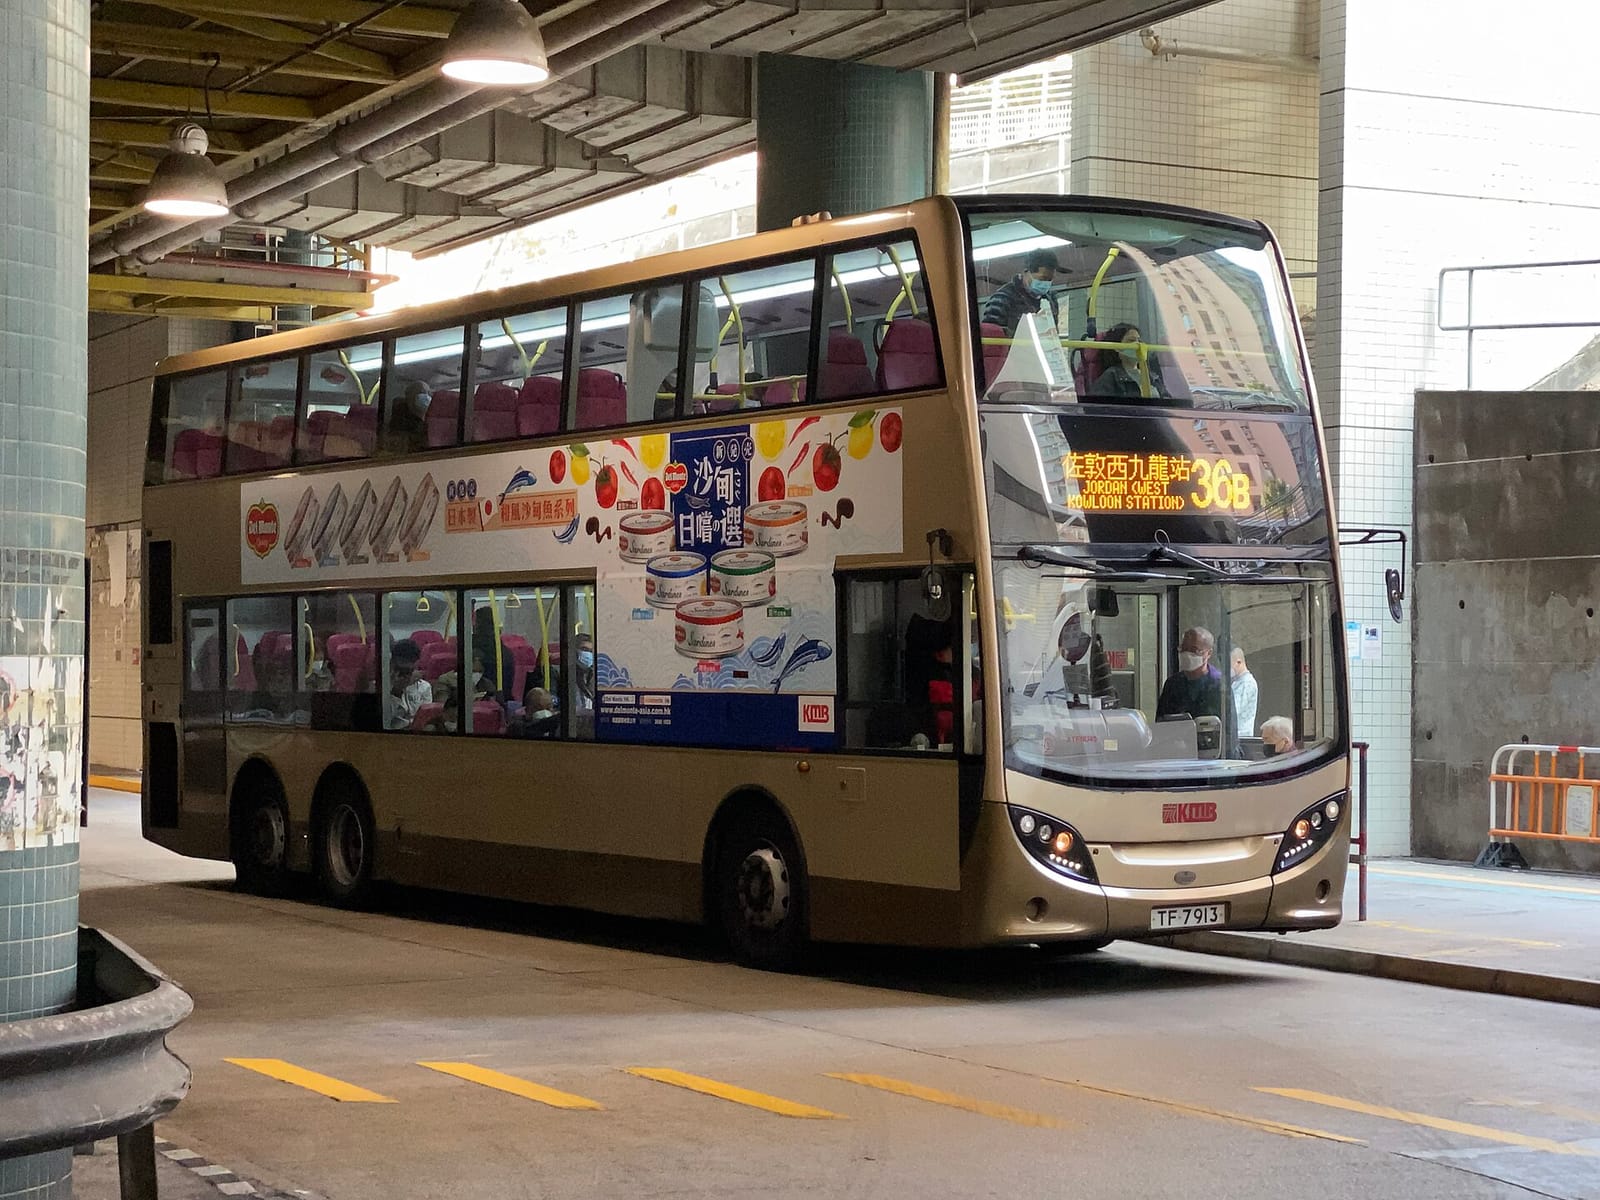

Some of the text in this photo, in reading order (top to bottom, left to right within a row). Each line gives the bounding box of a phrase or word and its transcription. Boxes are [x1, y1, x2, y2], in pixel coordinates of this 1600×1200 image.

[1062, 452, 1191, 481] 佐敦西九龍站
[693, 456, 734, 505] 沙甸
[1083, 481, 1170, 495] JORDAN (WEST
[1190, 458, 1250, 510] 36B
[1067, 494, 1185, 510] KOWLOON STATION)
[803, 704, 829, 723] KMB
[1157, 907, 1218, 926] TF 7913
